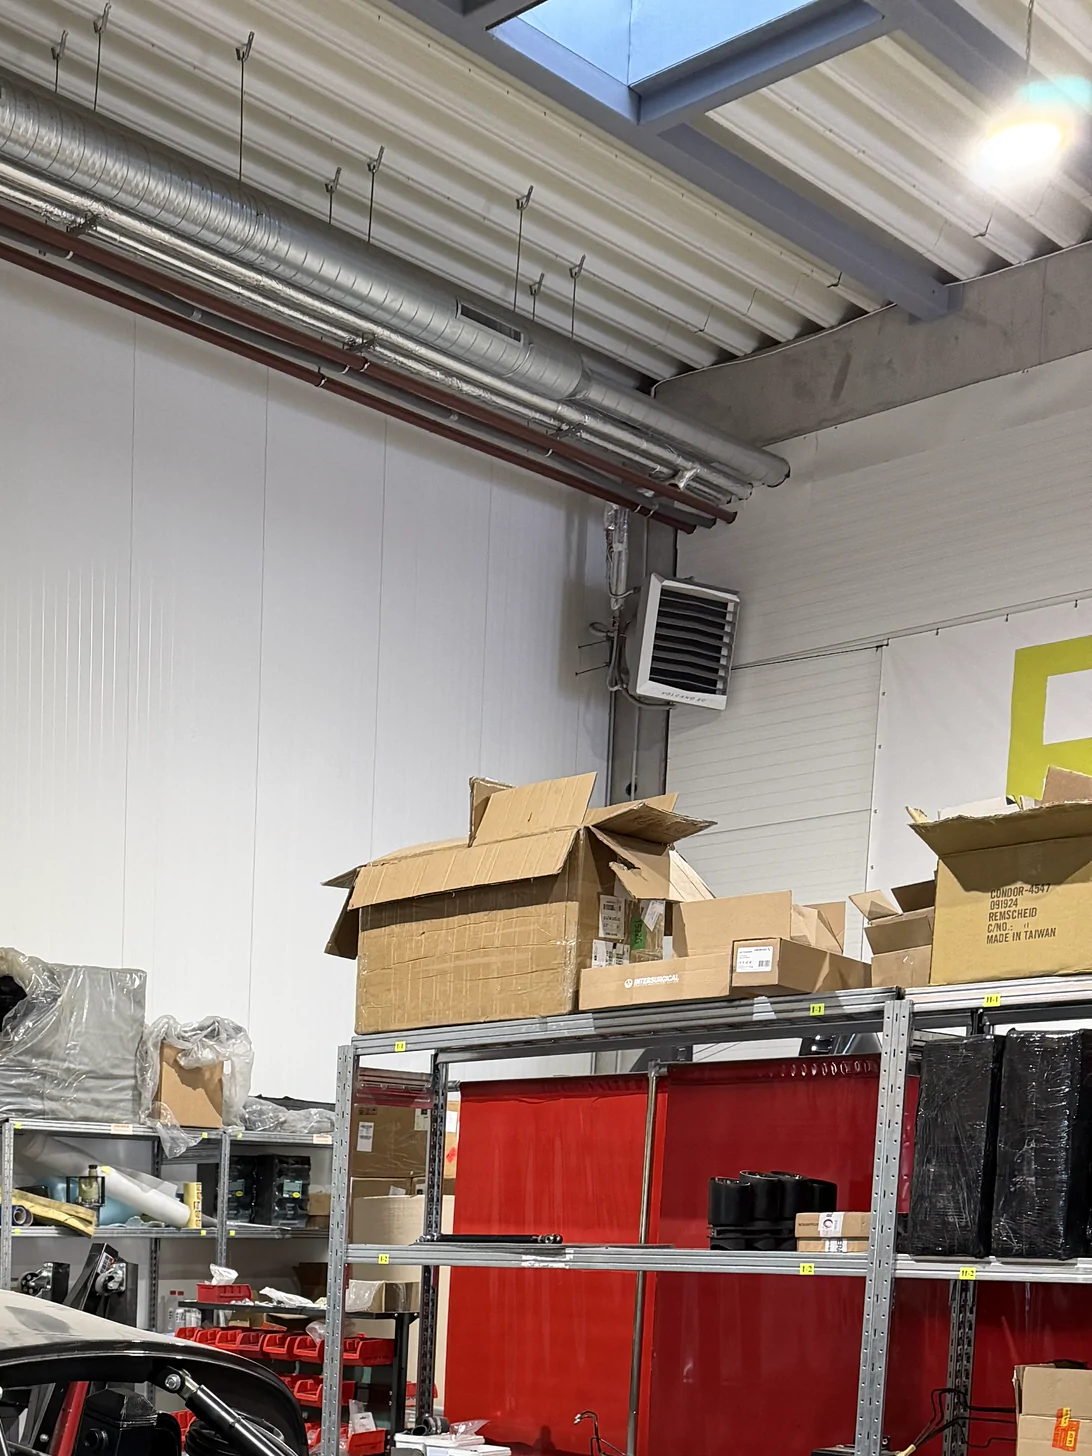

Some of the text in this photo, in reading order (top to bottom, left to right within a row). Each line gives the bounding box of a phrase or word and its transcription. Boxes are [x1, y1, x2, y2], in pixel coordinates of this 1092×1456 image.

[661, 691, 695, 701] VOLCANO
[990, 882, 1051, 899] CONDOR-4547
[990, 898, 1018, 910] 091924
[988, 907, 1037, 922] REMSCHEID
[987, 921, 1013, 933] C/NO.:
[986, 927, 1057, 944] MADE IN TAIWAN
